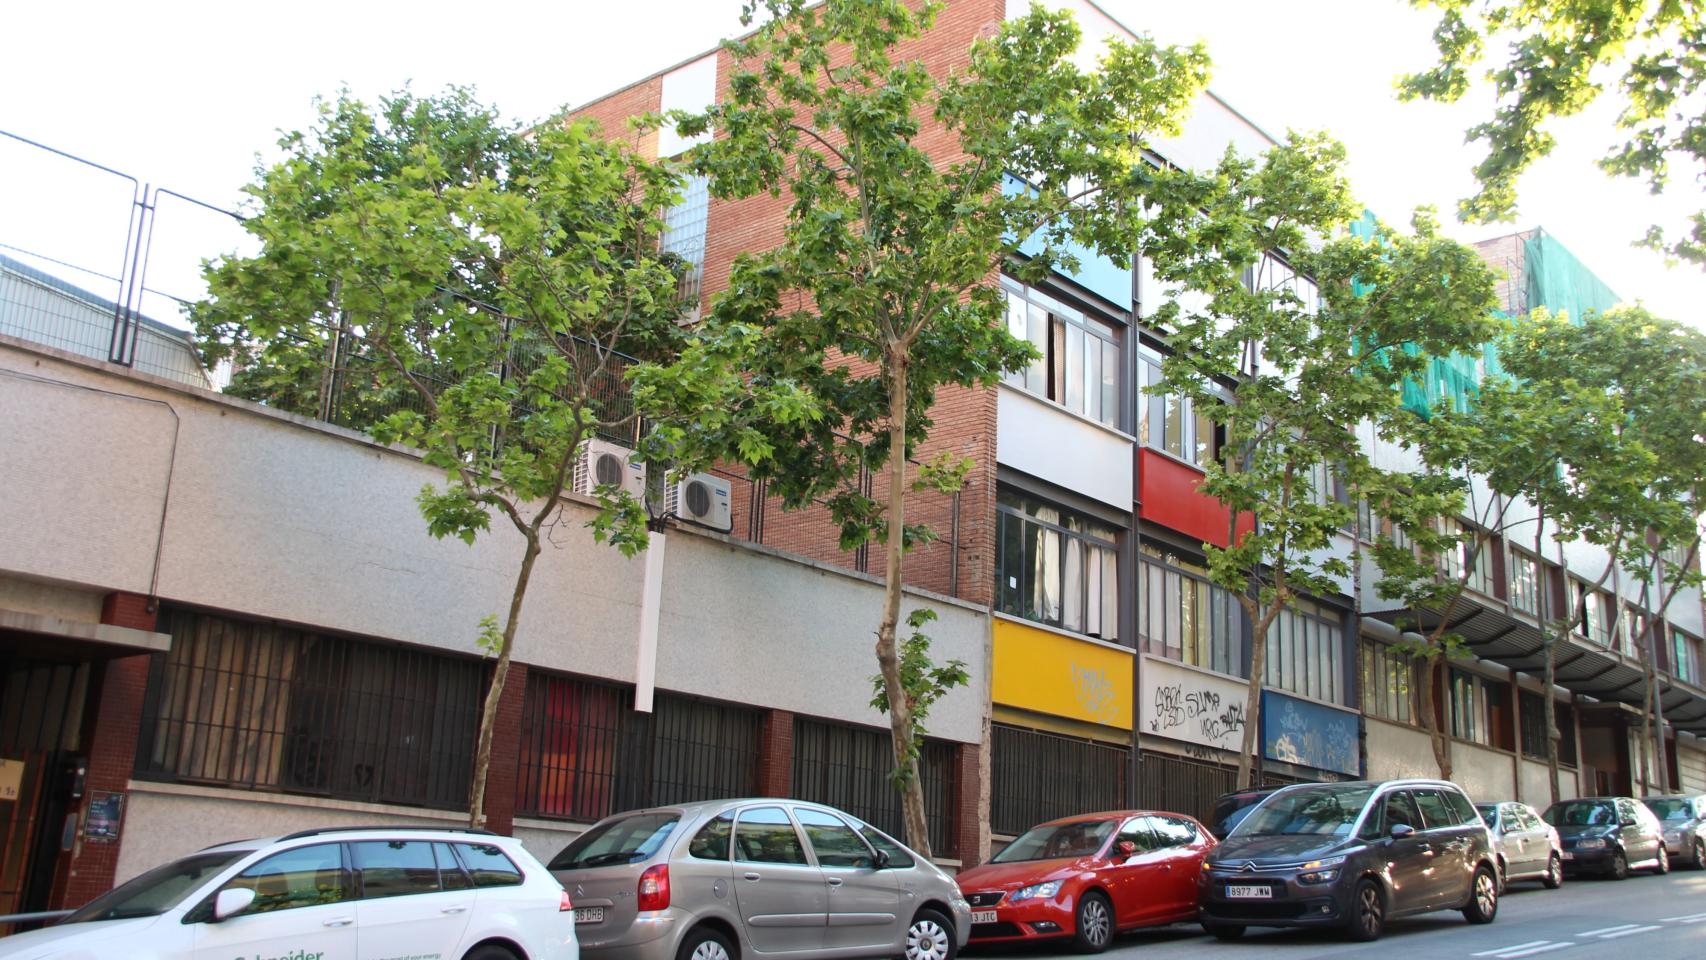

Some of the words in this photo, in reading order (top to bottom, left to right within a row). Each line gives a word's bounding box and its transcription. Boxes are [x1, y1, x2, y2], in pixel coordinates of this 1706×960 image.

[1231, 887, 1251, 897] 8977
[981, 912, 995, 921] JTC
[235, 949, 324, 960] heider
